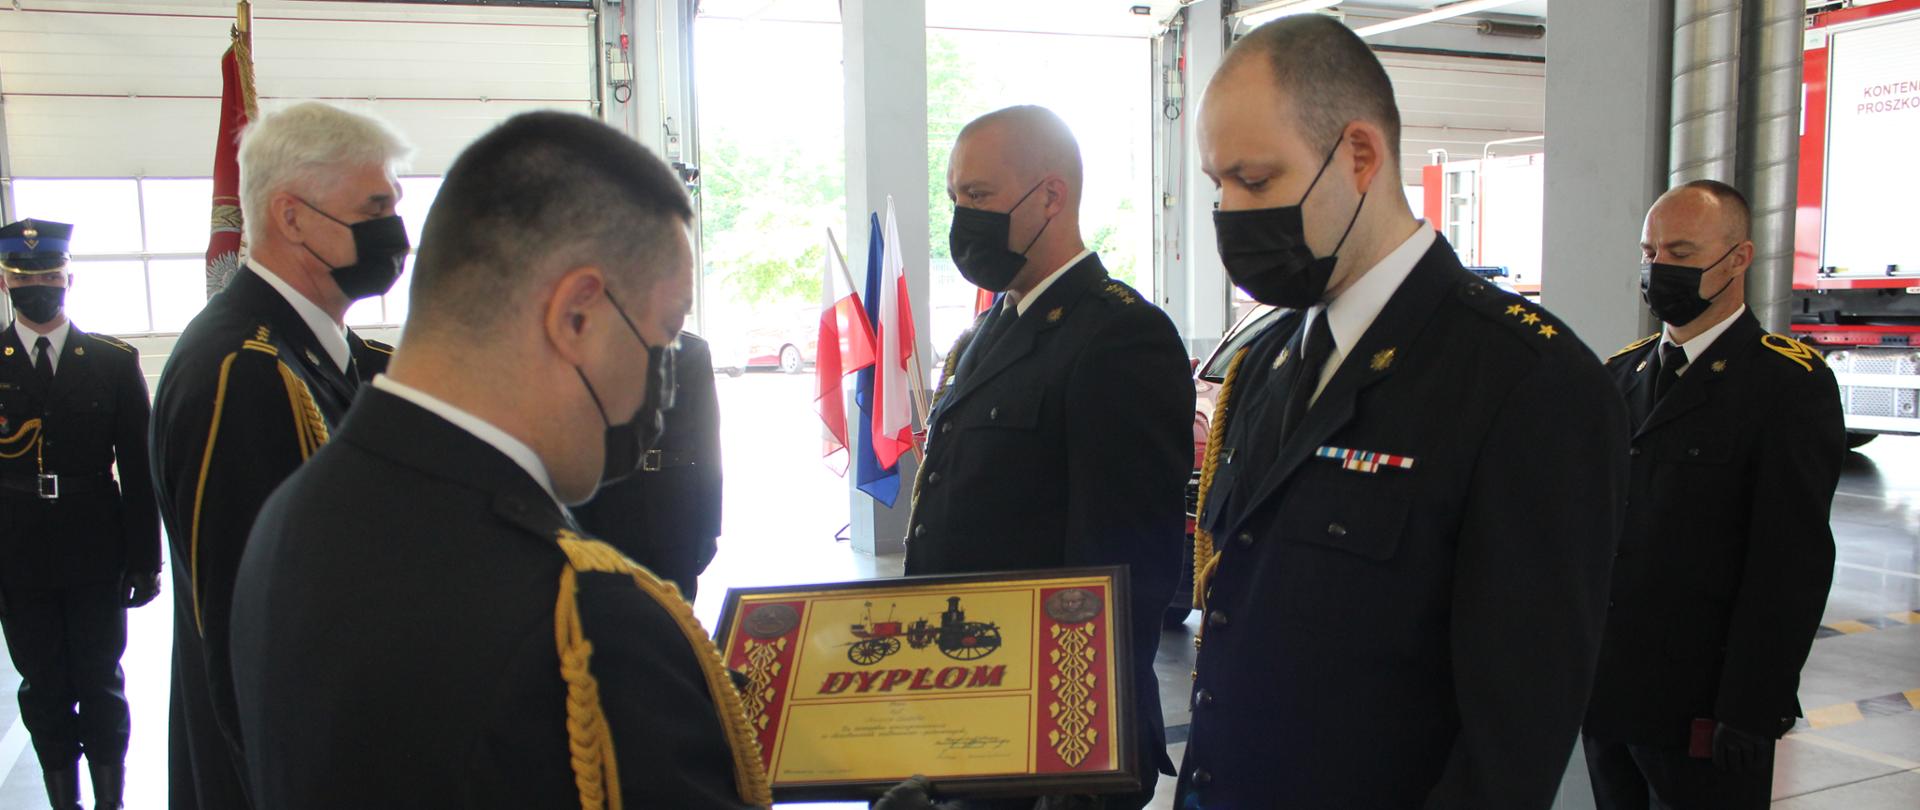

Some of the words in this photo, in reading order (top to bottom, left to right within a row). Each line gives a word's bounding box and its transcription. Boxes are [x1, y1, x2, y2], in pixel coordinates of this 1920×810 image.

[1864, 80, 1920, 98] KONTEN
[1857, 96, 1920, 115] PROSZKO
[817, 665, 1006, 694] DYPLOM
